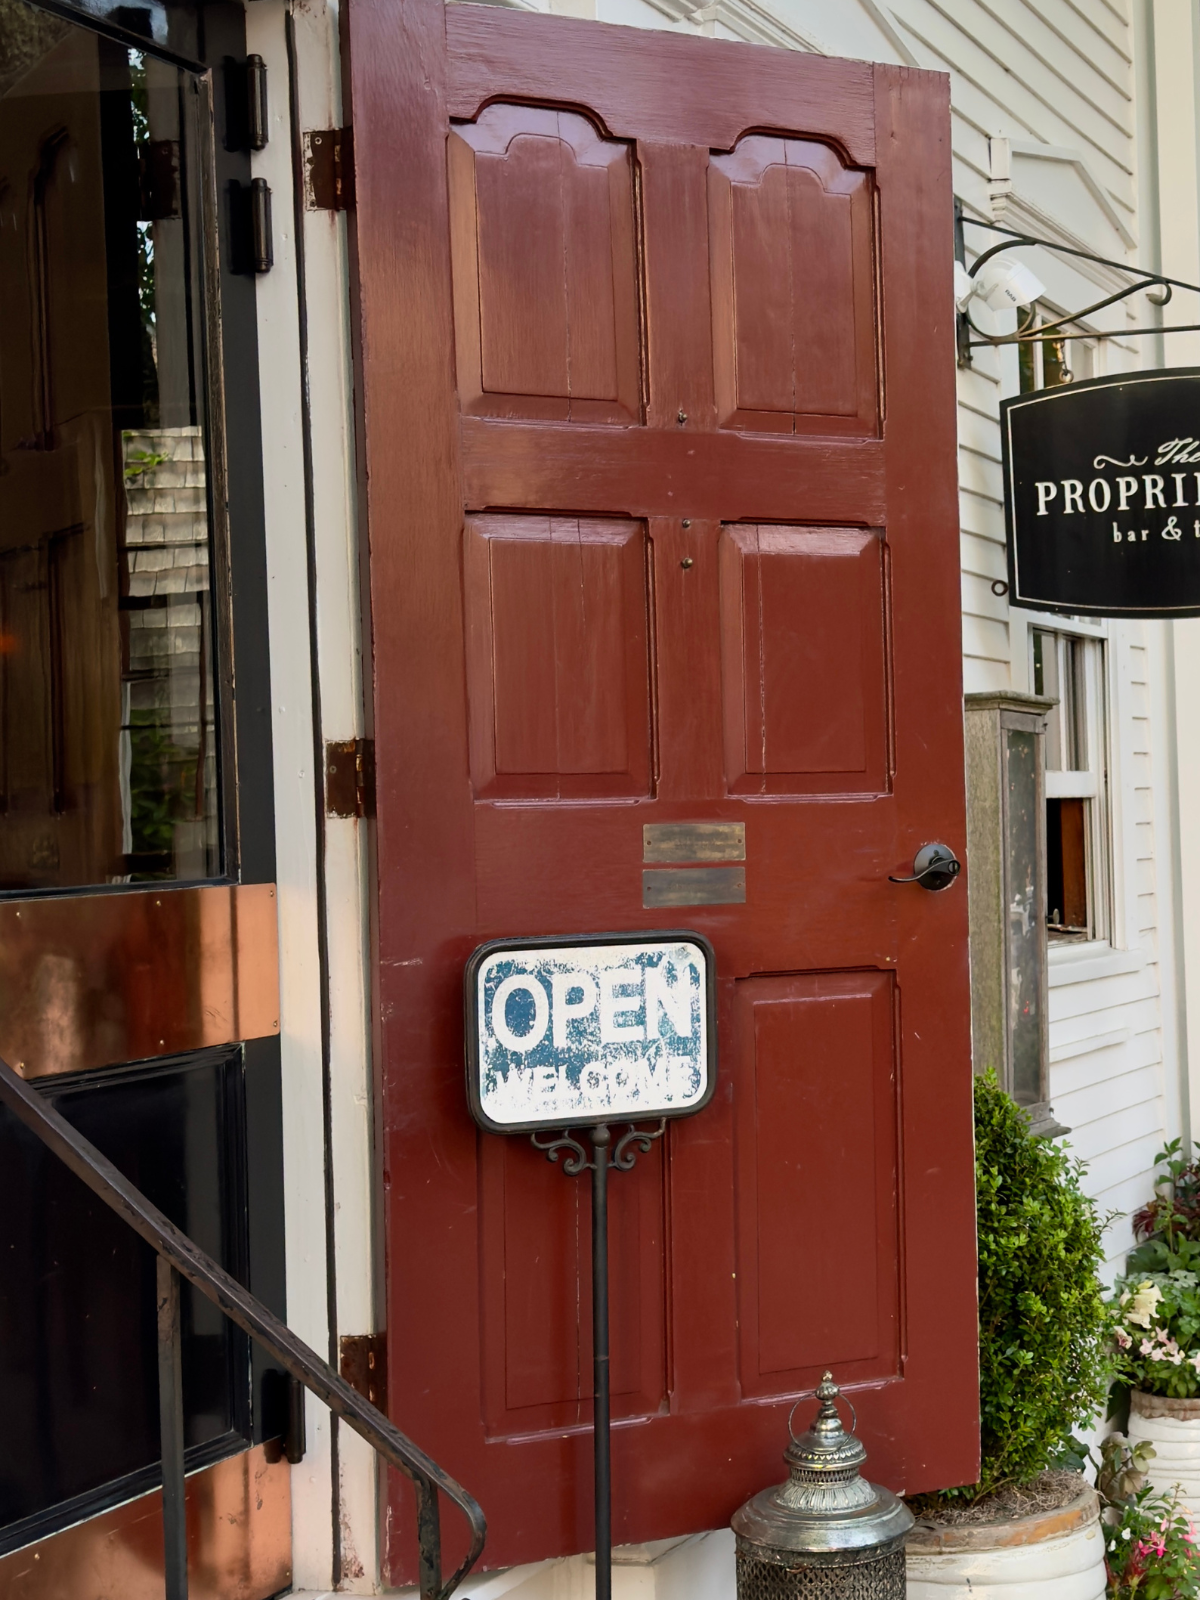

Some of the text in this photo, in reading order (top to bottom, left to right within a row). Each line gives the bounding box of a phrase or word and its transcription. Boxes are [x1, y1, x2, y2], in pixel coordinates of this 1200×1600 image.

[1112, 522, 1150, 543] bar
[1161, 516, 1182, 541] &
[492, 960, 692, 1052] OPEN
[492, 1055, 692, 1101] WELCOME
